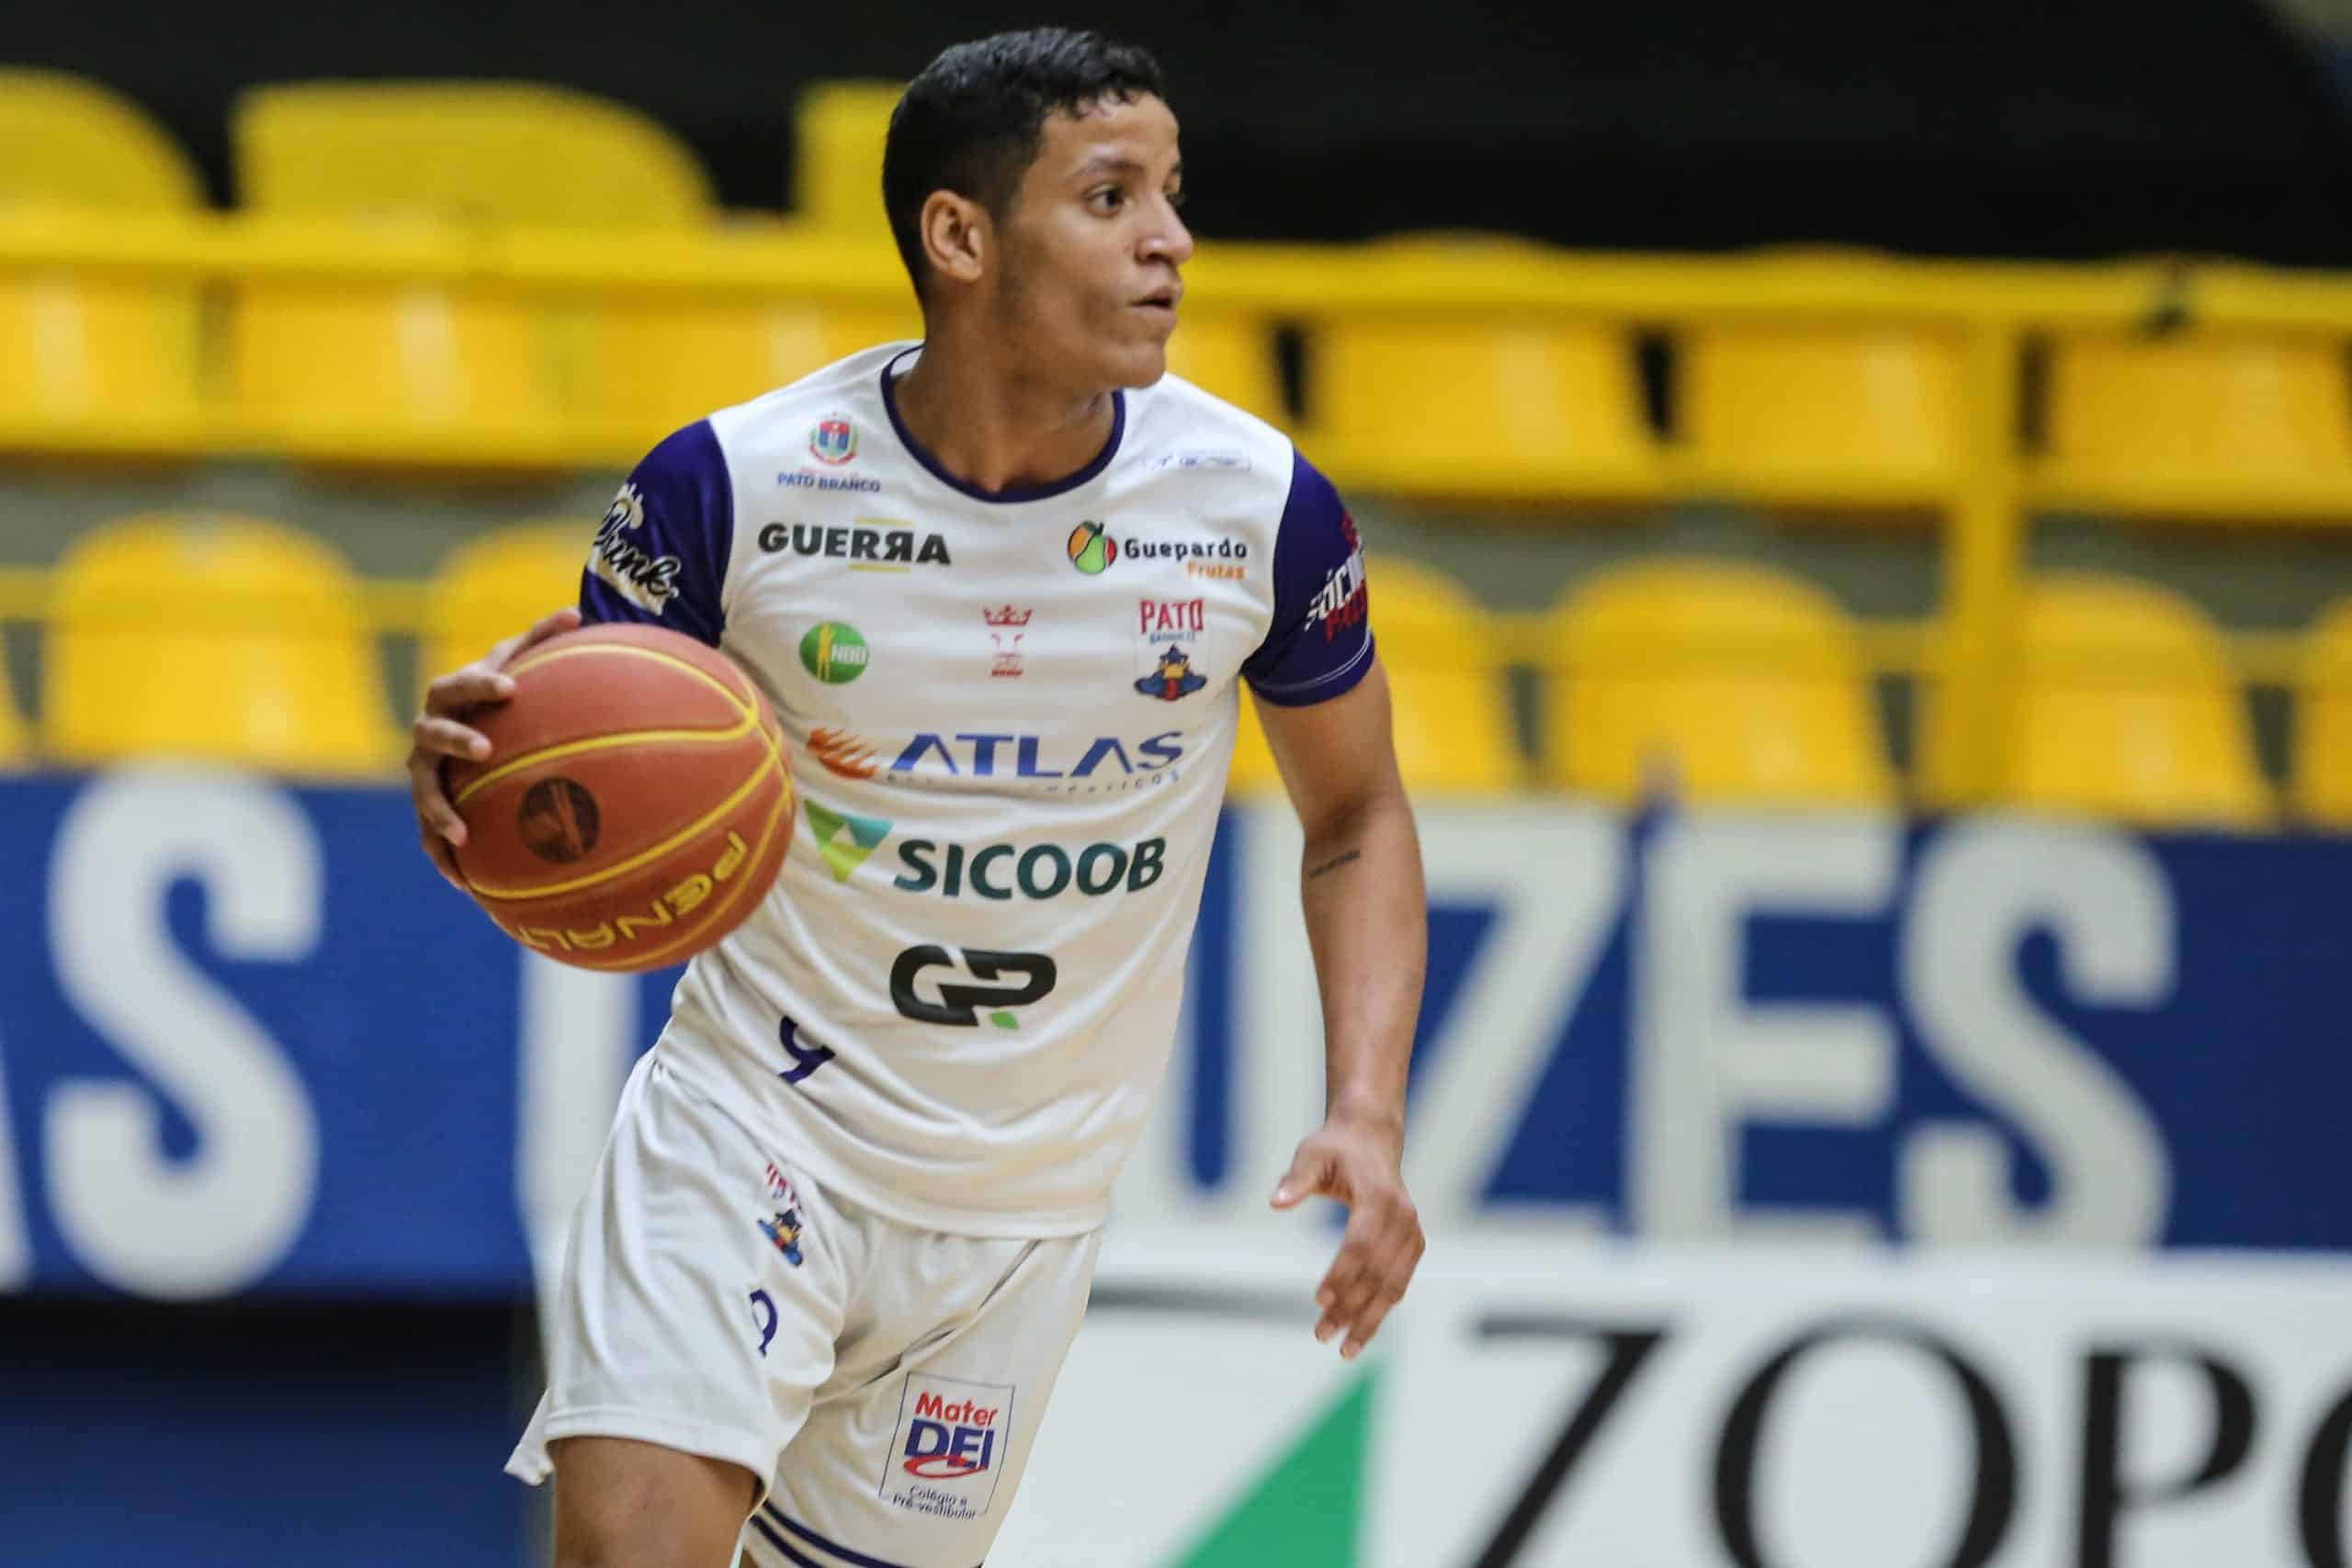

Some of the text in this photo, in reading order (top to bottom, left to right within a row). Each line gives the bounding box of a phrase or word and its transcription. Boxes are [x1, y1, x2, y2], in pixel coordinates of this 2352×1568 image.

[777, 472, 881, 492] PATO BRANCO
[1125, 537, 1248, 562] Guepardo
[1187, 561, 1244, 581] Frutas
[1139, 599, 1204, 635] PATO
[890, 731, 1183, 777] ATLAS
[518, 830, 749, 953] PENALT
[893, 837, 1166, 899] SICOOB
[890, 944, 1057, 1026] GP
[0, 758, 324, 1300] S
[915, 1392, 999, 1427] Mater
[905, 1418, 995, 1471] DEI
[1467, 1309, 2352, 1568] ZOP
